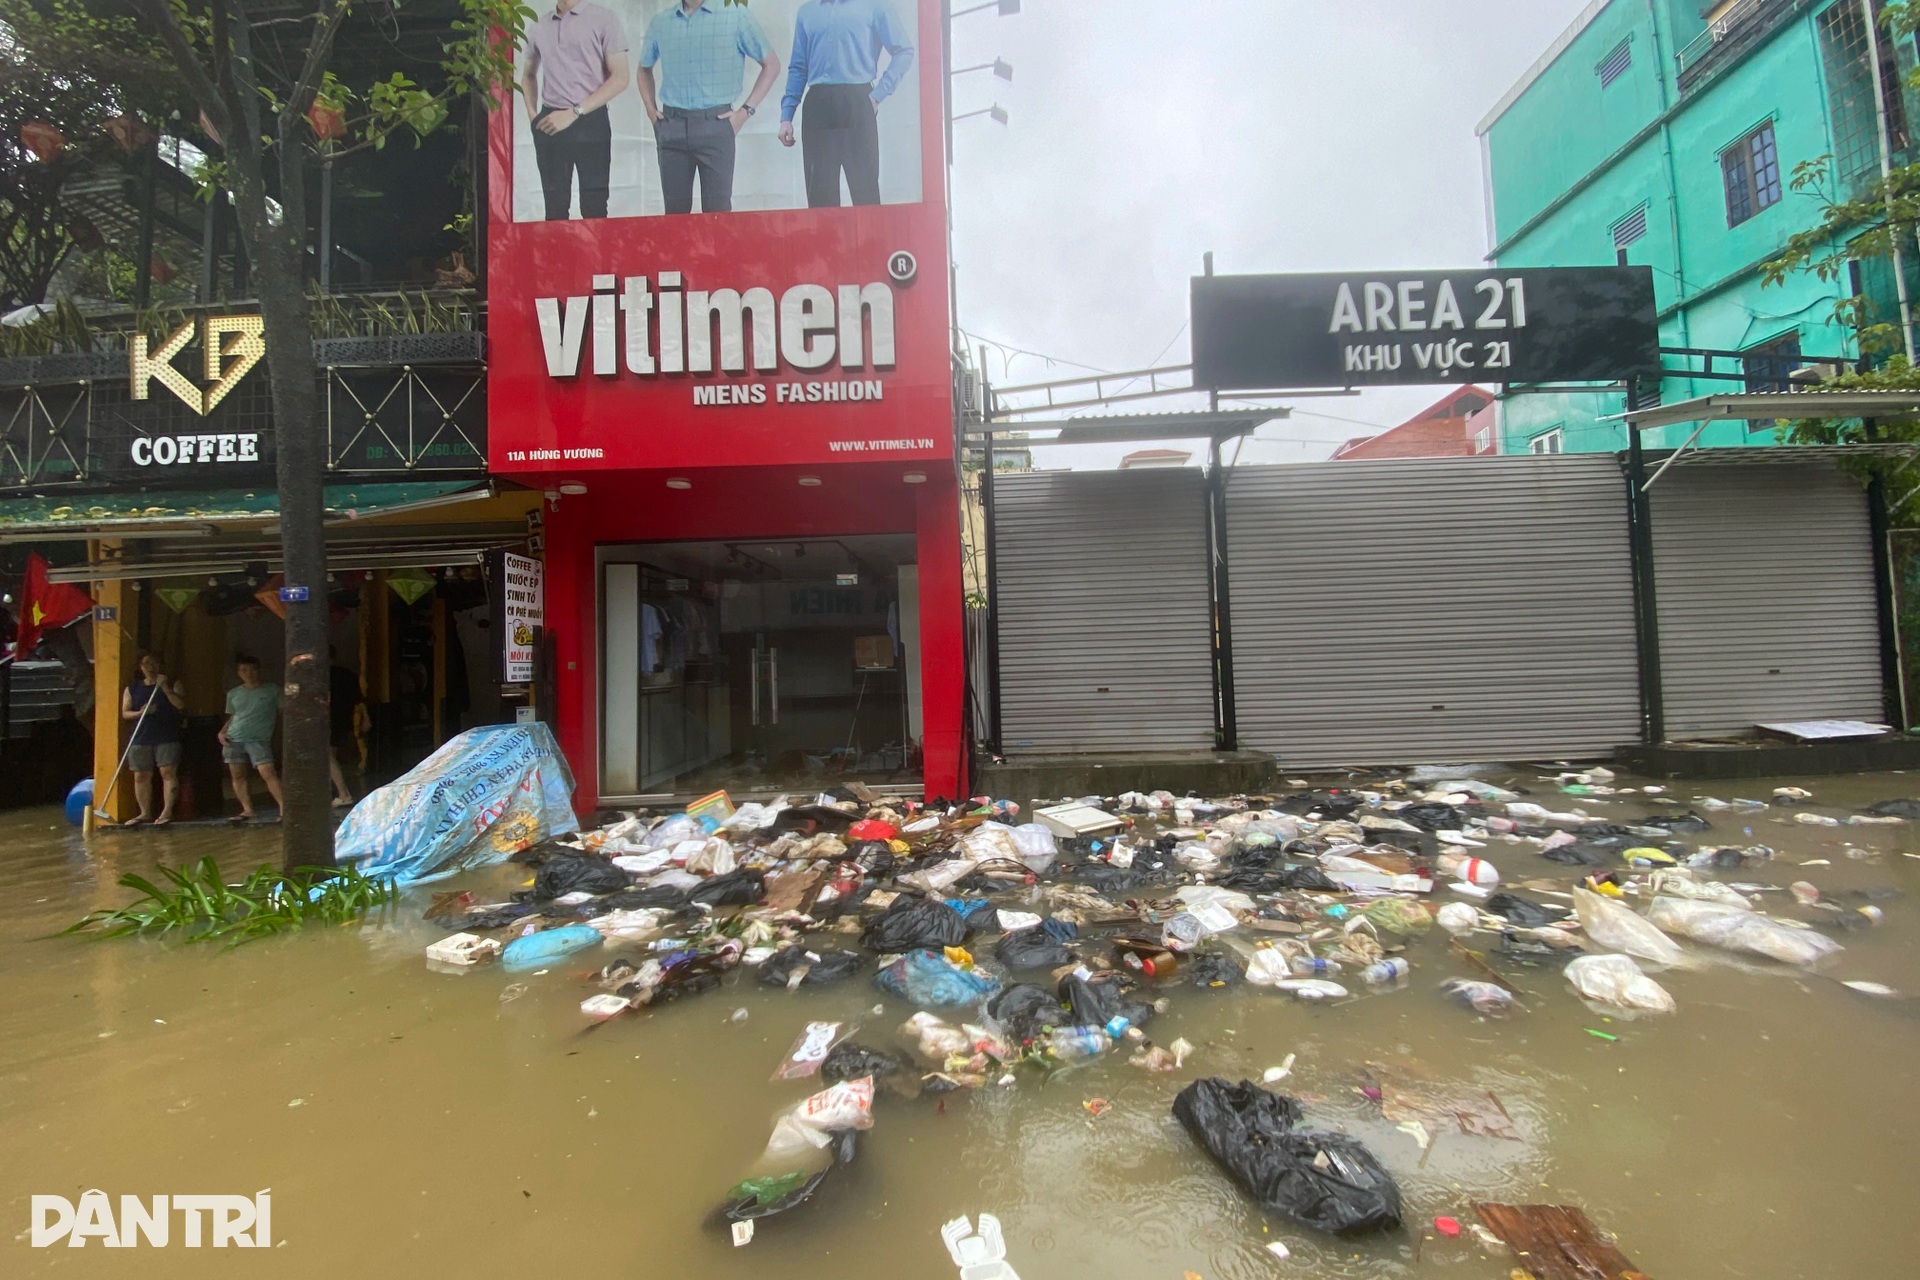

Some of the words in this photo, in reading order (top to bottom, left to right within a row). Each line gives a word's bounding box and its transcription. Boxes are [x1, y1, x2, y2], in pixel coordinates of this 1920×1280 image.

[1328, 279, 1464, 333] AREA
[1475, 278, 1527, 330] 21
[534, 271, 896, 376] vitimen
[1345, 343, 1402, 372] KHU
[1411, 338, 1475, 377] VỰC
[1483, 341, 1511, 368] 21
[693, 384, 766, 406] MENS
[776, 380, 883, 404] FASHION
[131, 433, 259, 466] COFFEE
[507, 451, 526, 461] 11A
[529, 448, 560, 460] HÙNG
[563, 448, 604, 459] VƯƠNG
[829, 439, 934, 451] WWW.VITIMEN.VN
[507, 556, 532, 572] COFFEE
[507, 589, 525, 602] SINH
